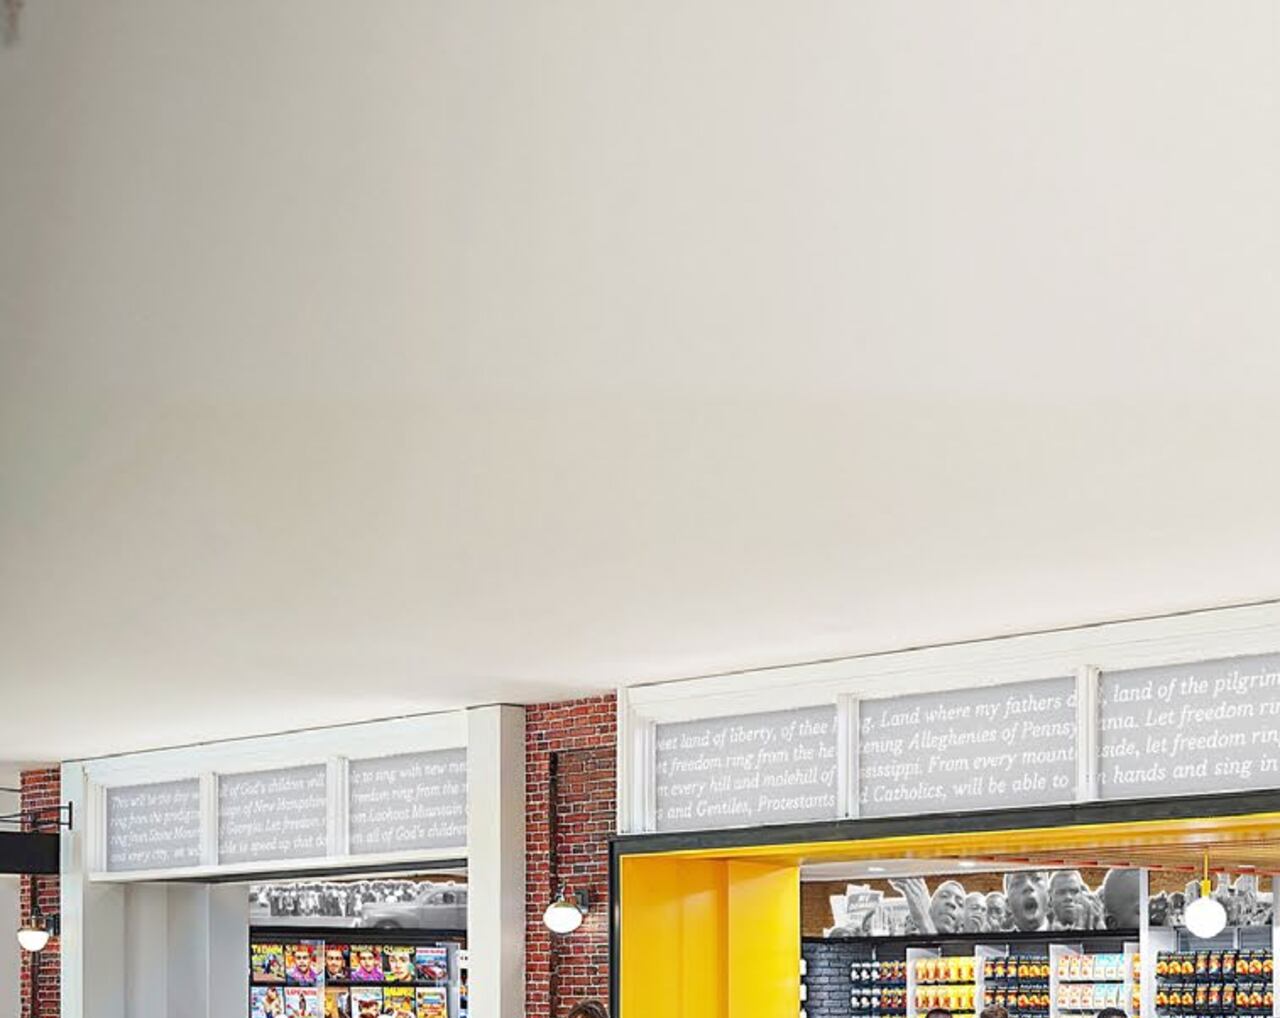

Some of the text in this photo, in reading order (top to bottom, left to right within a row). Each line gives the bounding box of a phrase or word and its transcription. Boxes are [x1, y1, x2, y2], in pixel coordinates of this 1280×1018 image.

[880, 707, 920, 728] Land
[926, 705, 972, 722] where
[975, 702, 1000, 720] my
[1003, 694, 1061, 719] fathers
[1113, 681, 1152, 703] land
[1158, 679, 1178, 705] of
[1180, 676, 1208, 696] the
[1001, 723, 1019, 745] of
[1145, 710, 1175, 727] Let
[1177, 703, 1253, 728] freedom
[928, 755, 969, 773] From
[973, 754, 1017, 772] every
[1145, 738, 1167, 753] let
[1170, 733, 1246, 757] freedom
[873, 781, 947, 801] Catholics,
[951, 778, 982, 795] will
[988, 776, 1007, 794] be
[1011, 773, 1047, 793] able
[1053, 774, 1069, 788] to
[1113, 762, 1167, 784] hands
[1172, 757, 1208, 778] and
[1214, 757, 1252, 778] sing
[1260, 756, 1278, 771] in
